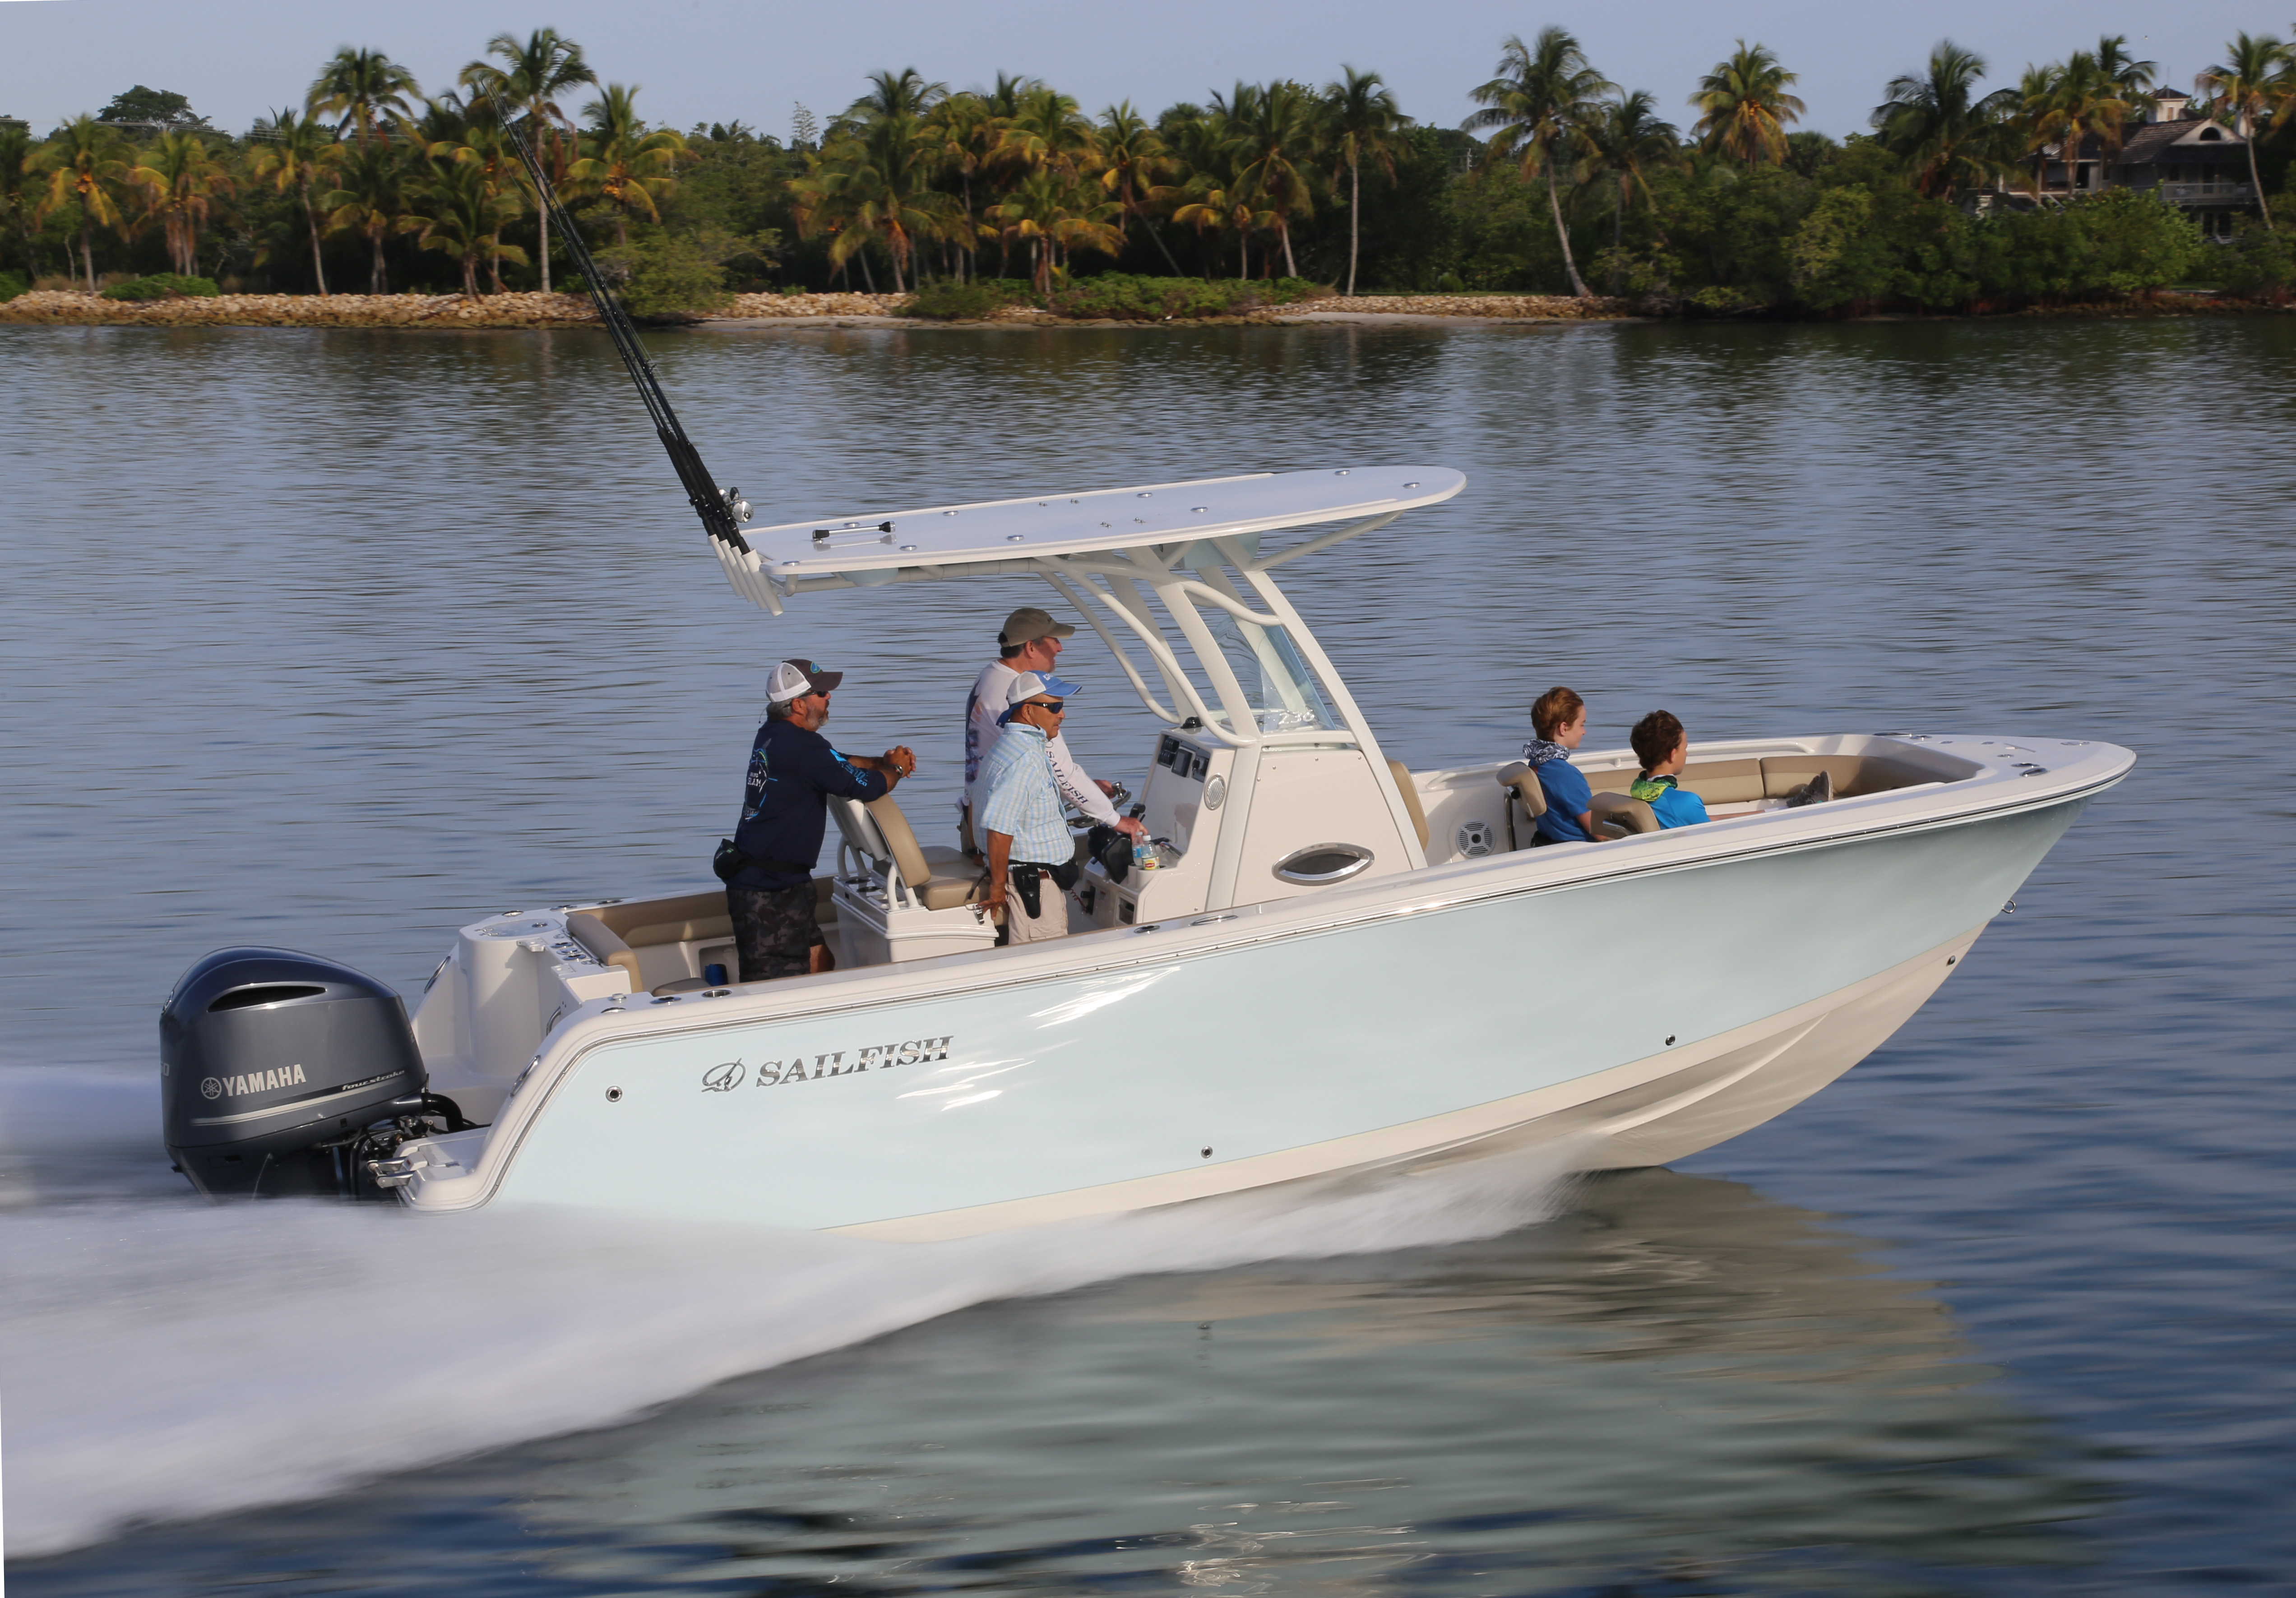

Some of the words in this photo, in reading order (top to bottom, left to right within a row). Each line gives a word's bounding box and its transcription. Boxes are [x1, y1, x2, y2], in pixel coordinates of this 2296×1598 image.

[1046, 751, 1089, 804] SAILFISH
[222, 1064, 306, 1096] YAMAHA
[756, 1036, 954, 1087] SAILFISH
